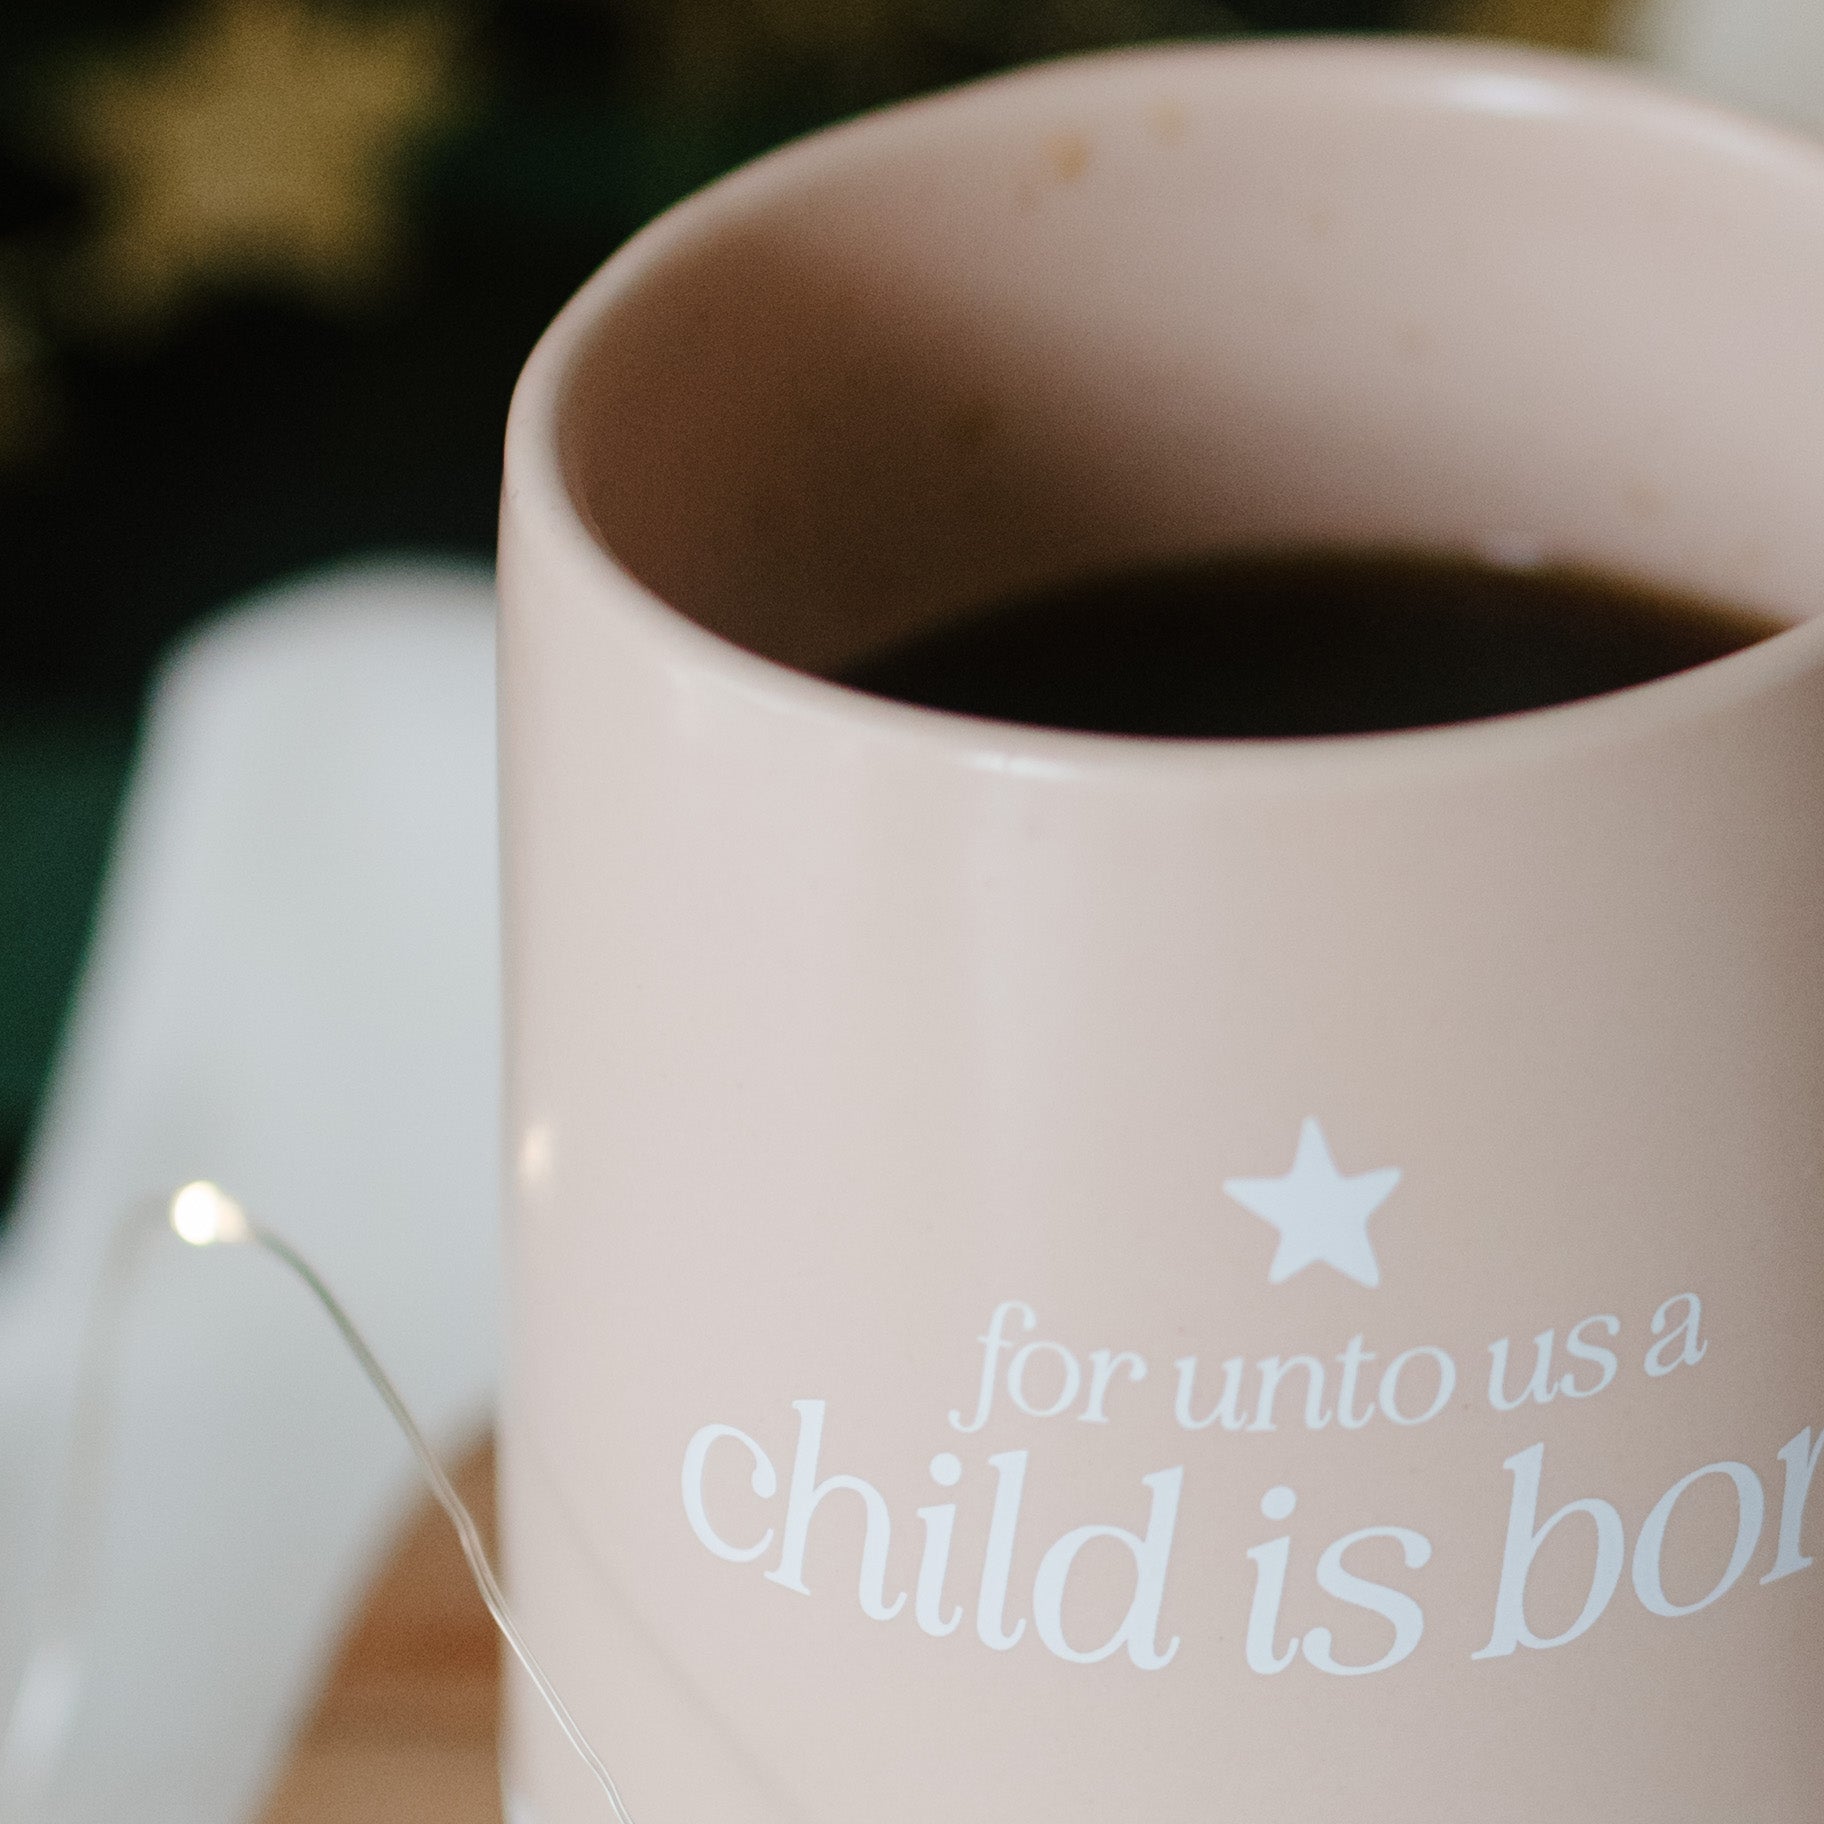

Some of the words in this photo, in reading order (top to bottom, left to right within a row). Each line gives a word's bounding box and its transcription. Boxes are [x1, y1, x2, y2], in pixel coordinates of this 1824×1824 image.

[949, 1301, 1147, 1433] for
[1173, 1334, 1455, 1433] unto
[1487, 1314, 1620, 1412] us
[1643, 1292, 1707, 1379] a
[680, 1399, 1184, 1671] child
[1245, 1485, 1432, 1675] is
